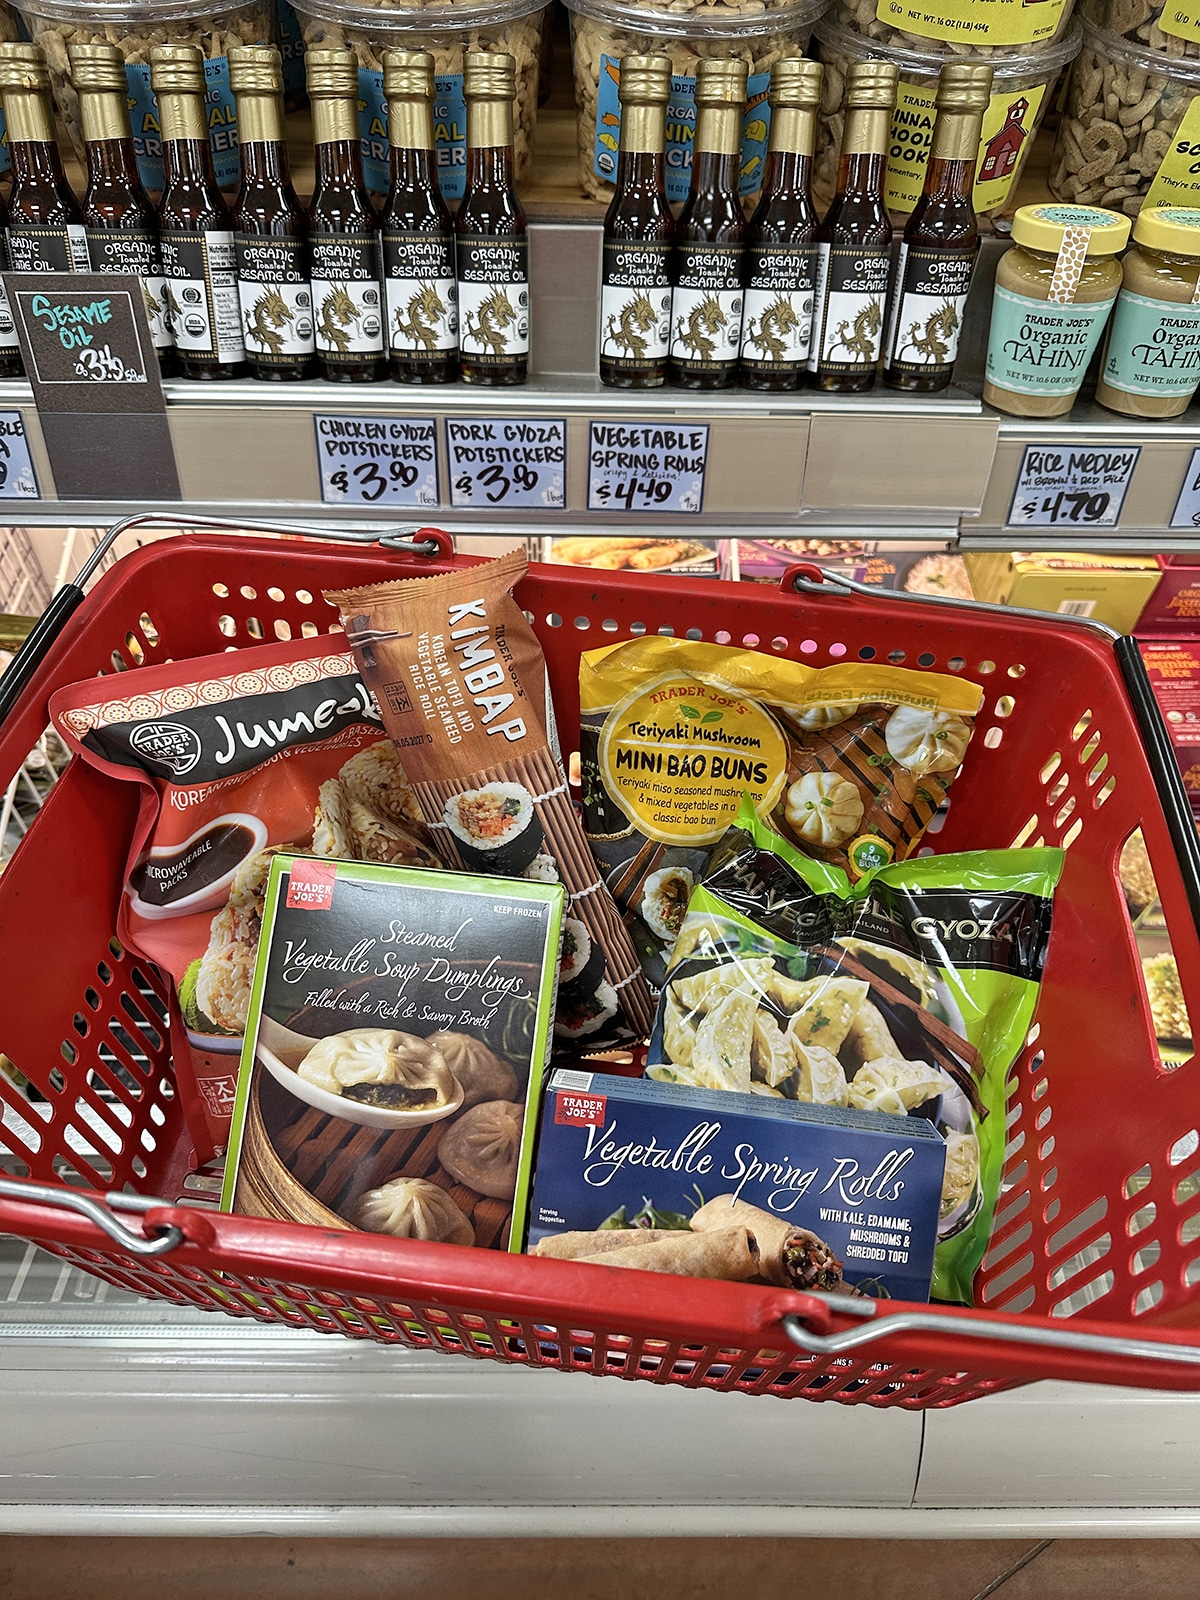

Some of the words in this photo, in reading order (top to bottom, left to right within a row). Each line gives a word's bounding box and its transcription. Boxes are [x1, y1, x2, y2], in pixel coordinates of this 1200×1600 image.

[908, 10, 921, 20] NET
[937, 17, 944, 26] 16
[945, 19, 955, 28] OZ
[104, 242, 156, 255] ORGANIC
[398, 243, 447, 258] ORGANIC
[470, 248, 520, 263] ORGANIC
[33, 261, 55, 271] OIL
[616, 253, 666, 266] ORGANIC
[173, 266, 191, 277] OIL
[392, 266, 438, 277] SESAME
[464, 269, 510, 282] SESAME
[608, 273, 654, 286] SESAME
[1025, 314, 1063, 327] TRADER
[1066, 318, 1092, 327] JOE'S
[1160, 317, 1200, 329] TRADER
[1020, 325, 1087, 349] Organic
[1006, 370, 1021, 381] NET
[1050, 375, 1061, 384] OZ
[1133, 373, 1150, 383] NET
[1179, 377, 1189, 385] OZ
[319, 420, 386, 441] CHICKEN
[390, 423, 435, 442] GYOZA
[450, 424, 496, 441] PORK
[504, 425, 561, 443] GYOZA
[593, 426, 703, 451] VEGETABLE
[325, 440, 433, 462] POTSTICKERS
[453, 446, 565, 464] POTSTICKERS
[591, 450, 660, 471] SPRING
[664, 455, 705, 475] ROLLS
[1034, 476, 1068, 486] BROWN
[448, 598, 527, 742] KIMBAP
[409, 663, 426, 690] RICE
[419, 694, 437, 720] ROLL
[417, 631, 442, 694] VEGETABLE
[434, 696, 462, 744] SEAWEED
[432, 634, 452, 676] KOREAN
[444, 677, 465, 707] TOFU
[456, 709, 475, 733] AND
[369, 690, 379, 704] NET
[650, 686, 706, 705] TRADER
[709, 693, 749, 716] JOE'S
[137, 731, 192, 753] TRADER
[628, 721, 689, 743] Teriyaki
[693, 726, 761, 749] Mushroom
[153, 741, 188, 758] JOE'S
[616, 748, 663, 774] MINI
[667, 754, 707, 779] BAO
[710, 756, 768, 785] BUNS
[617, 776, 651, 791] Teriyaki
[652, 780, 672, 794] miso
[674, 785, 712, 797] seasoned
[638, 793, 645, 803] &
[646, 796, 672, 809] mixed
[674, 798, 719, 813] vegetables
[720, 800, 729, 811] in
[730, 803, 736, 812] a
[653, 812, 682, 825] classic
[683, 814, 699, 825] bao
[701, 814, 716, 825] bun
[861, 853, 881, 863] BAO
[869, 845, 876, 854] 9
[160, 869, 188, 892] PACKS
[291, 881, 332, 895] TRADER
[293, 891, 326, 904] JOE'S
[493, 904, 512, 916] KEEP
[513, 906, 543, 919] FROZEN
[380, 918, 473, 952] Steamed
[910, 917, 1013, 943] GYOZA
[283, 938, 376, 984] Vegetable
[374, 951, 421, 997] Soup
[422, 955, 532, 1008] Dumplings
[303, 988, 347, 1009] Filled
[339, 994, 363, 1012] with
[363, 1003, 372, 1014] a
[372, 1000, 400, 1020] Rich
[402, 1003, 416, 1018] &
[417, 1006, 457, 1033] Savory
[457, 1007, 498, 1030] Broth
[562, 1097, 603, 1112] TRADER
[565, 1107, 600, 1120] JOE'S
[583, 1120, 722, 1187] Vegetable
[721, 1143, 819, 1212] Spring
[820, 1147, 916, 1207] Rolls
[539, 1207, 558, 1216] Serving
[539, 1214, 566, 1224] Suggestion
[819, 1207, 842, 1222] WITH
[843, 1211, 866, 1227] KALE,
[867, 1214, 912, 1232] EDAMAME,
[850, 1229, 901, 1246] MUSHROOMS
[903, 1236, 911, 1248] &
[846, 1244, 886, 1260] SHREDDED
[888, 1249, 909, 1264] TOFU
